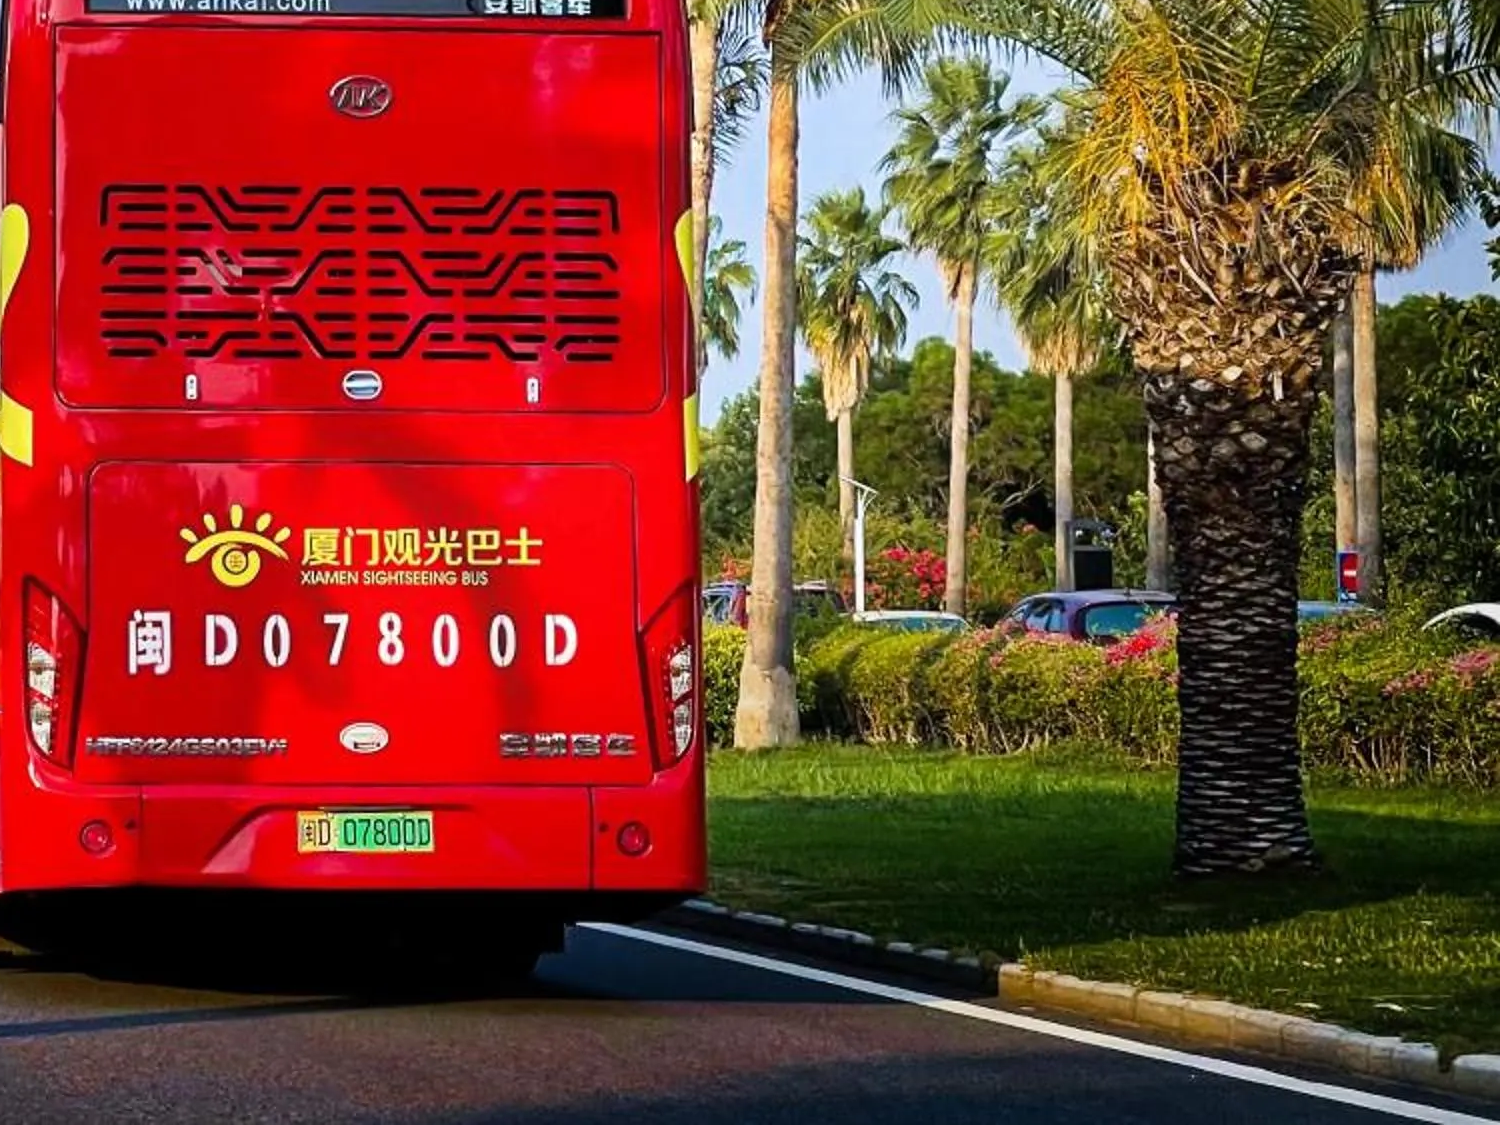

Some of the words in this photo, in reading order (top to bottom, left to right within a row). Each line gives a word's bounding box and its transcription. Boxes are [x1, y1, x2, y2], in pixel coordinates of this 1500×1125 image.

[301, 526, 544, 566] 厦门观光巴士
[300, 570, 359, 586] XIAMEN
[363, 570, 457, 586] SIGHTSEEING
[461, 570, 489, 586] BUS
